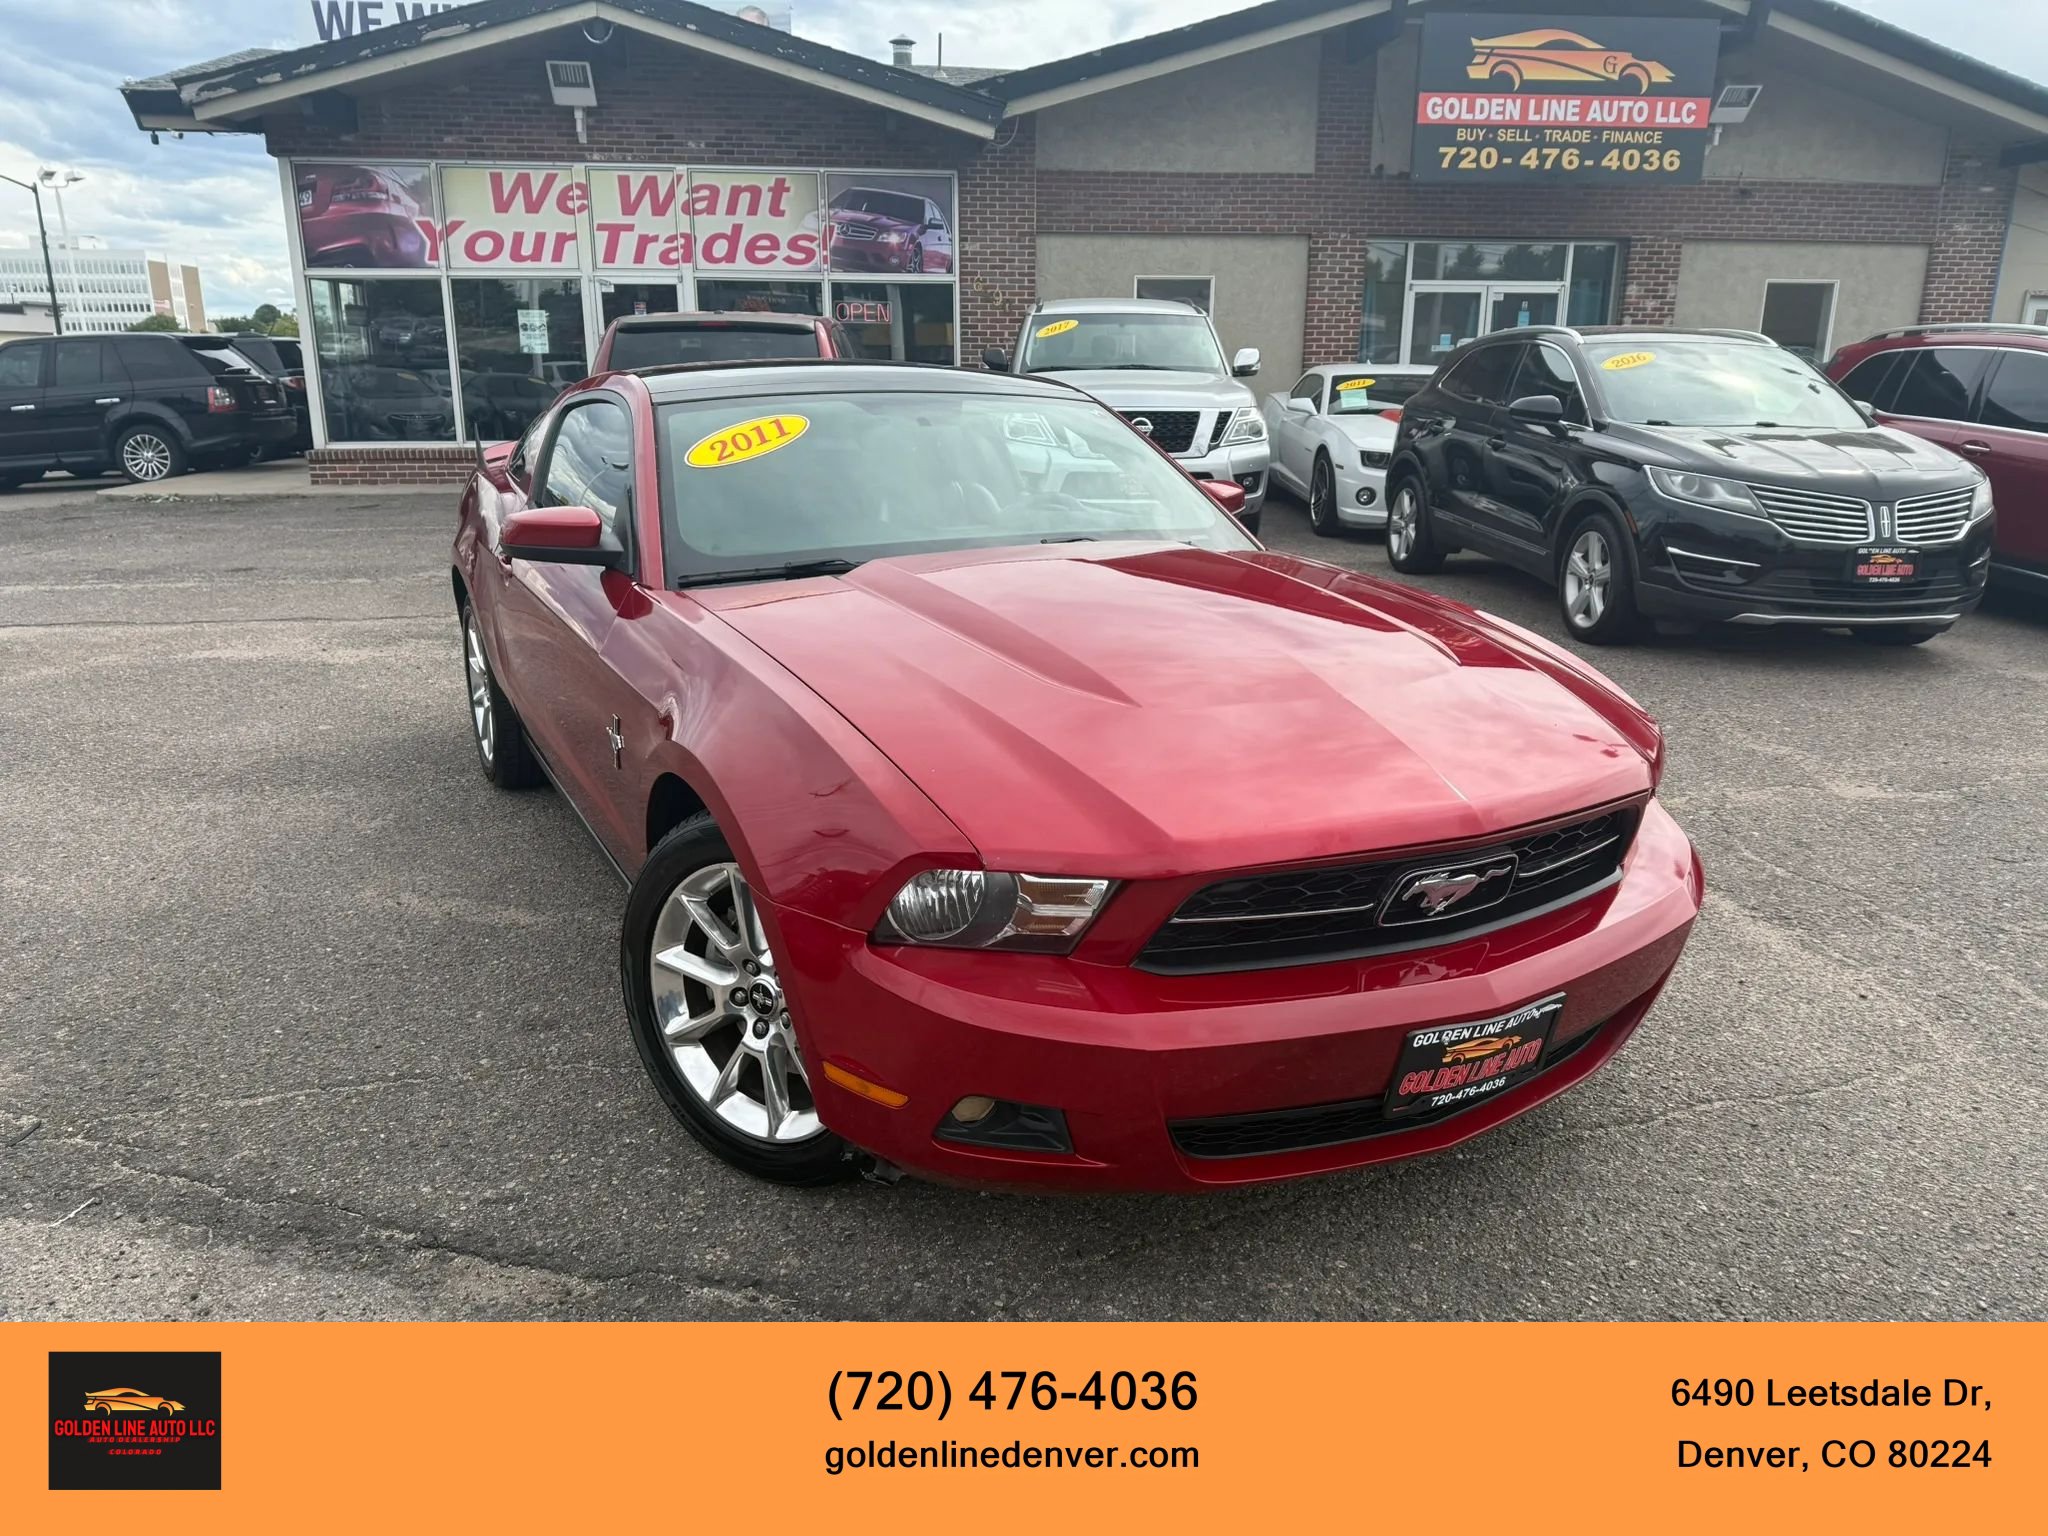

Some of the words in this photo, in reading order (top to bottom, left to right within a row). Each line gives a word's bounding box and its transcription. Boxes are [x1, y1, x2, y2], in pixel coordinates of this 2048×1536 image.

[1426, 96, 1521, 121] GOLDEN
[1528, 98, 1580, 122] LINE
[1586, 99, 1649, 123] AUTO
[1655, 101, 1697, 124] LLC
[1456, 128, 1486, 141] BUY
[1497, 129, 1532, 142] SELL
[1544, 130, 1591, 143] TRADE
[1602, 131, 1663, 144] FINANCE
[488, 171, 589, 216] We
[616, 174, 791, 217] Want
[415, 219, 577, 264] Your
[596, 223, 836, 266] Trades!
[836, 303, 891, 323] OPEN
[1044, 321, 1070, 336] 2017
[1611, 352, 1647, 368] 2016
[708, 418, 792, 462] 2011
[1413, 1027, 1472, 1048] GOLDEN
[1474, 1021, 1506, 1037] LINE
[1504, 1008, 1537, 1030] AUTO
[1398, 1063, 1468, 1096] GOLDEN
[1467, 1052, 1503, 1083] LINE
[1501, 1037, 1543, 1073] AUTO
[1431, 1076, 1507, 1107] 720-476-4036
